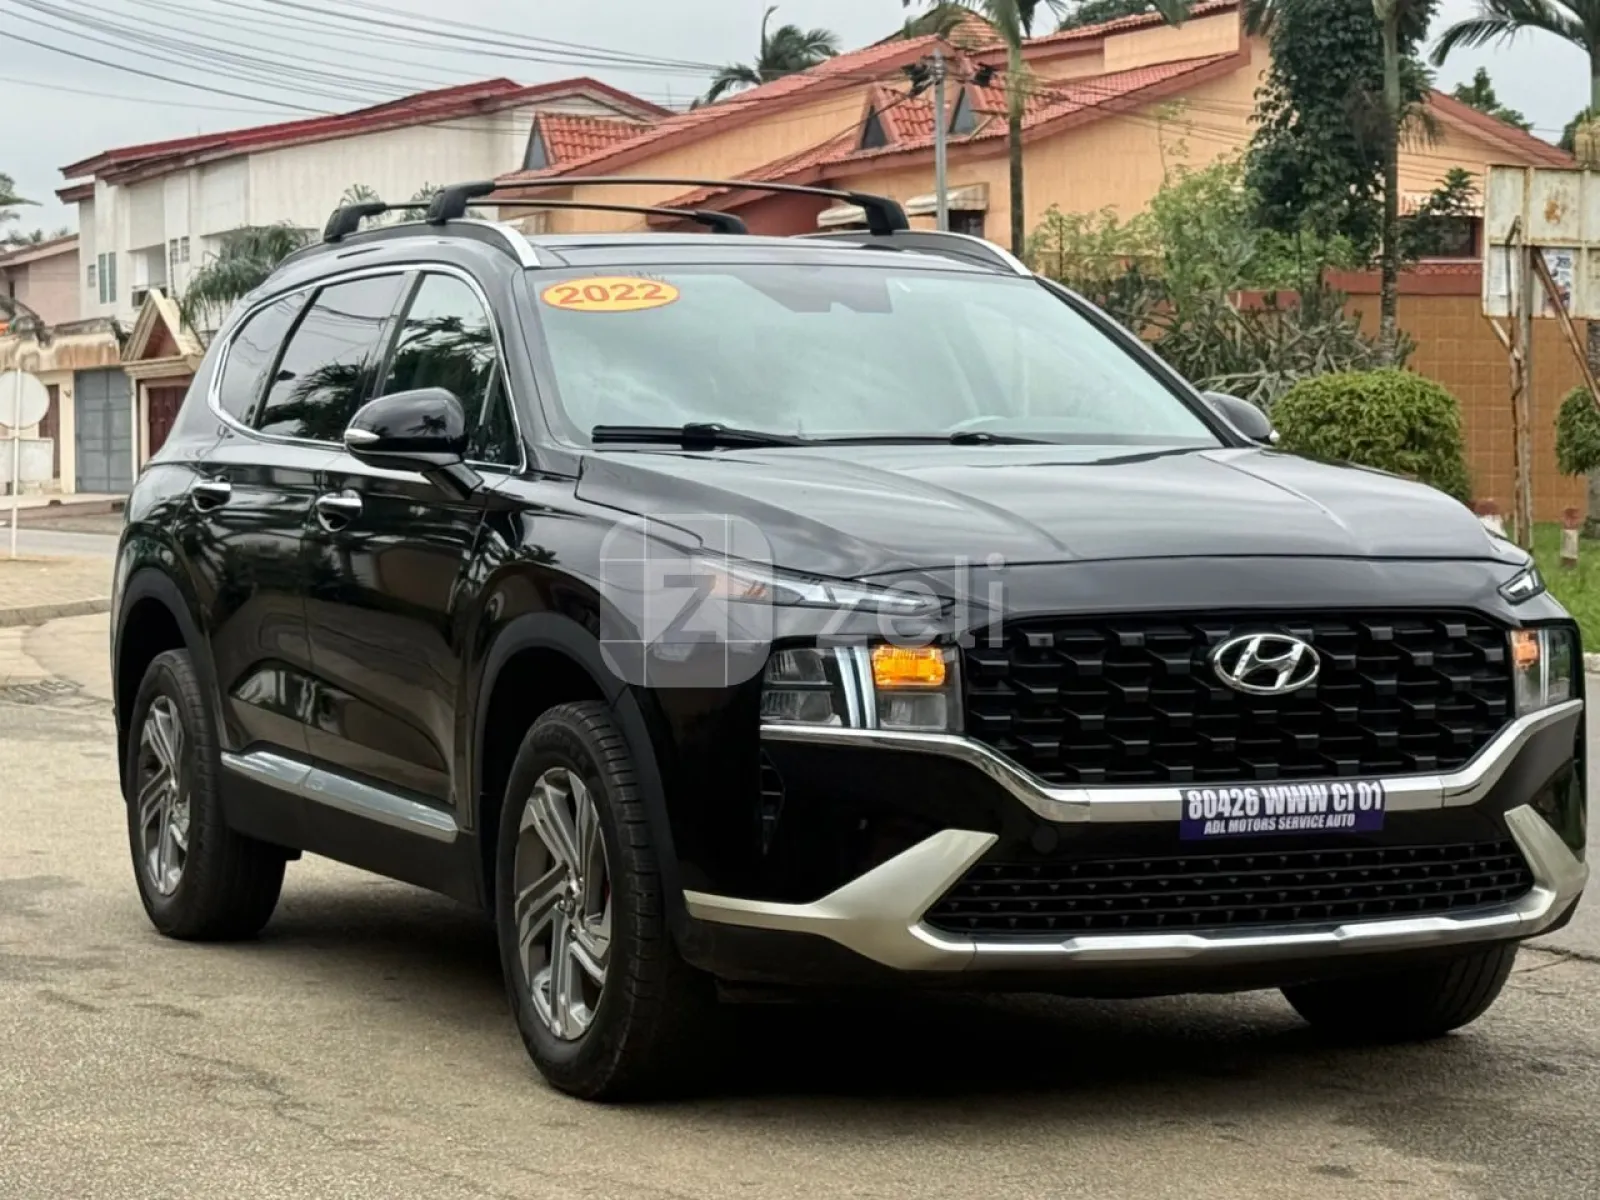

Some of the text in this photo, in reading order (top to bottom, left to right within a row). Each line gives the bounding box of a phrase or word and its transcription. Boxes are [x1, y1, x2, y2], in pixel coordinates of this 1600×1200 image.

[554, 283, 667, 305] 2022
[1187, 788, 1260, 820] 80426
[1261, 784, 1328, 816] WWW
[1228, 817, 1276, 833] MOTORS
[1278, 815, 1325, 831] SERVICE
[1325, 813, 1356, 829] AUTO
